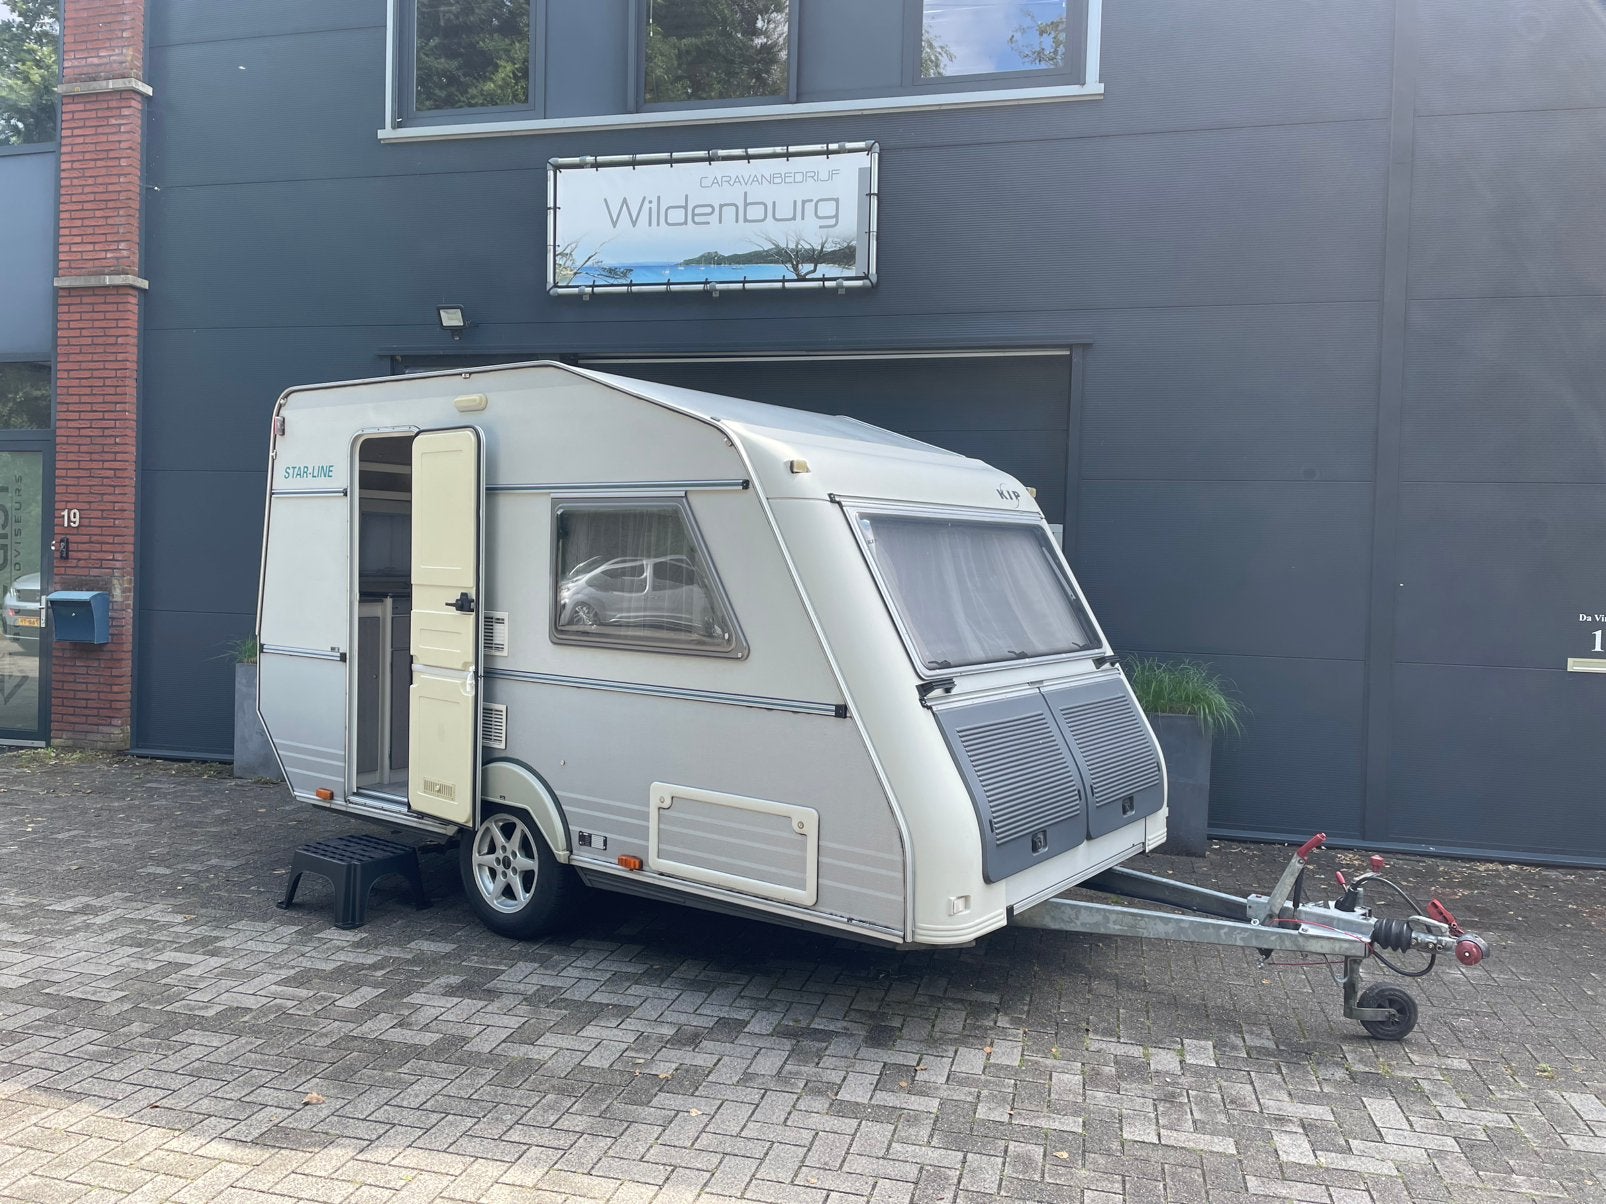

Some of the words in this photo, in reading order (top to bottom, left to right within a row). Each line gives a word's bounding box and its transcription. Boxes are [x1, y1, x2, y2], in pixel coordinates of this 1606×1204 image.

[699, 168, 841, 189] CARAVANBEDRIJF
[603, 191, 840, 229] Wildenburg
[283, 464, 334, 479] STAR-LINE
[996, 487, 1020, 502] KIP
[60, 508, 80, 528] 19
[1579, 613, 1592, 622] Da
[1594, 614, 1606, 622] Vi
[1591, 629, 1604, 652] 1
